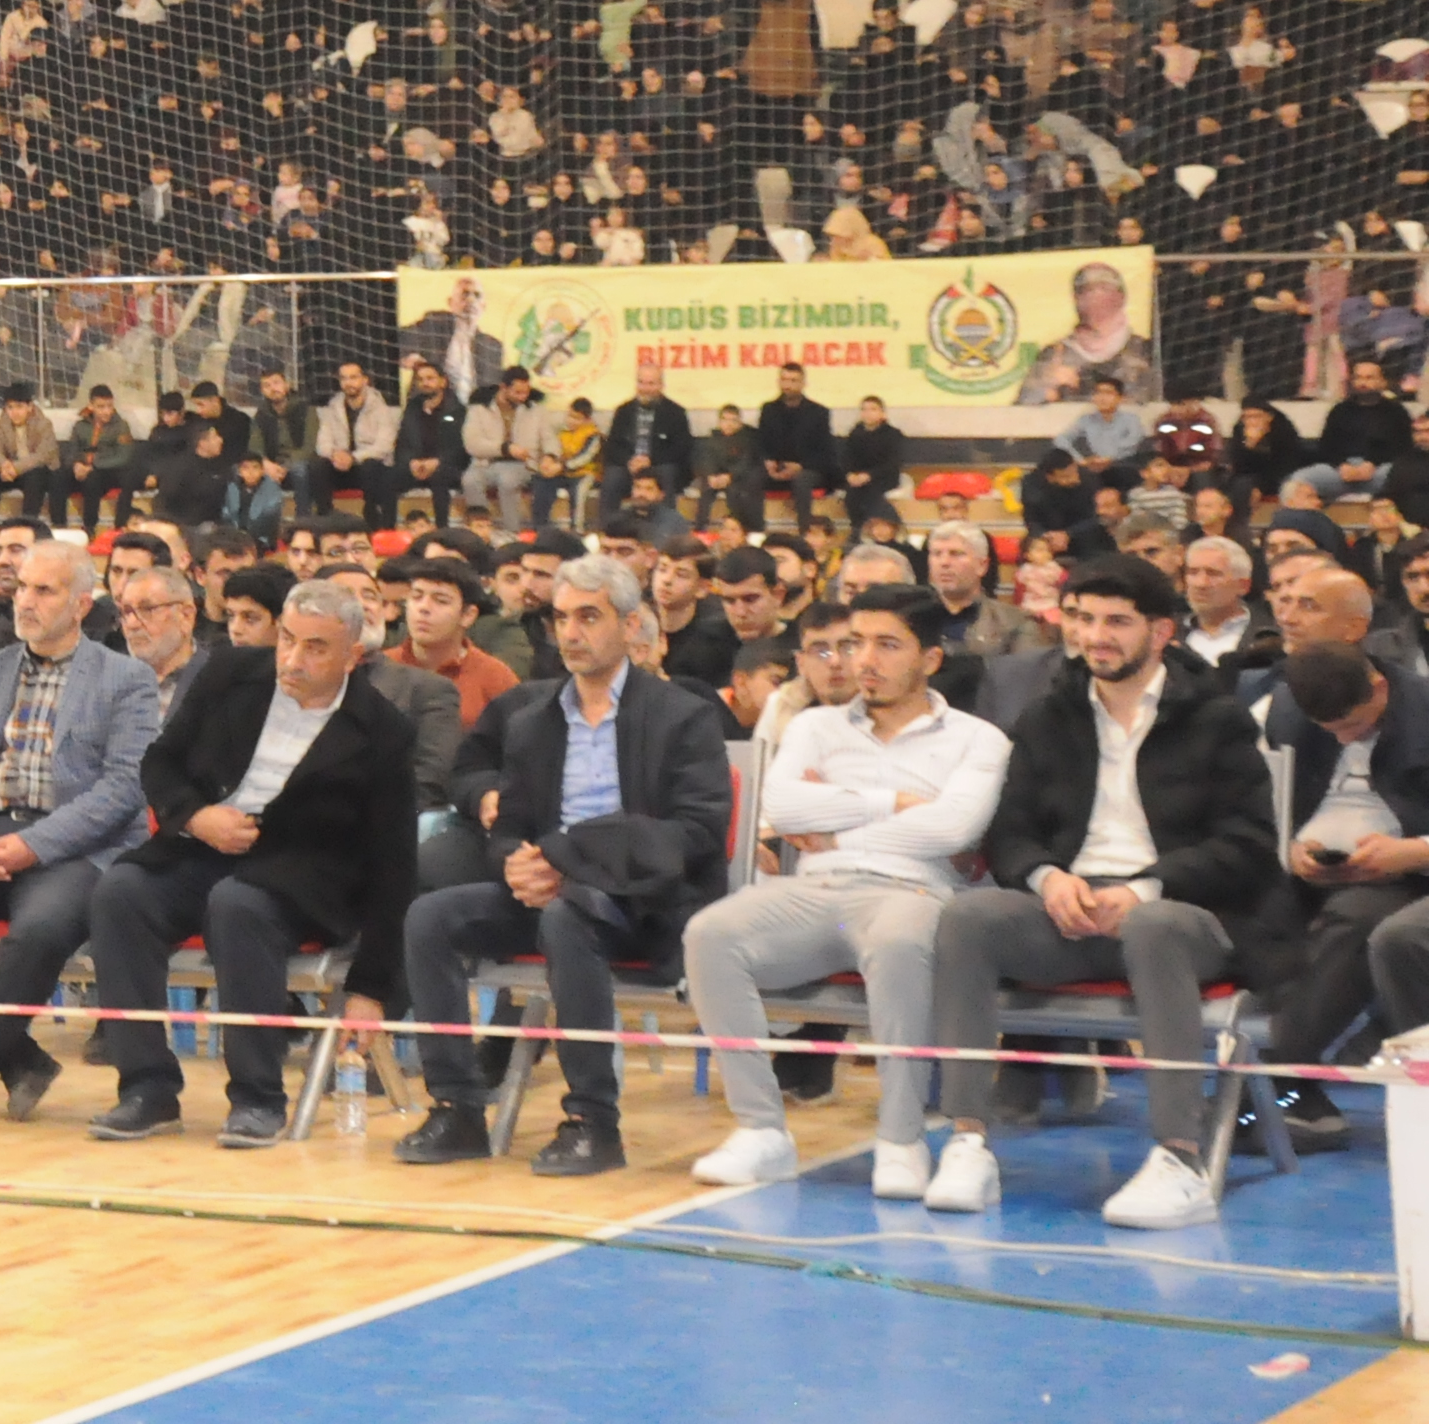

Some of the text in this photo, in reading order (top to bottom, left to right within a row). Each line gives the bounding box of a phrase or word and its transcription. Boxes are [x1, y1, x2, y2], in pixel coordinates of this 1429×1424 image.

[623, 295, 900, 332] KUDÜS BİZİMDİR,
[635, 338, 887, 369] BİZİM KALACAK
